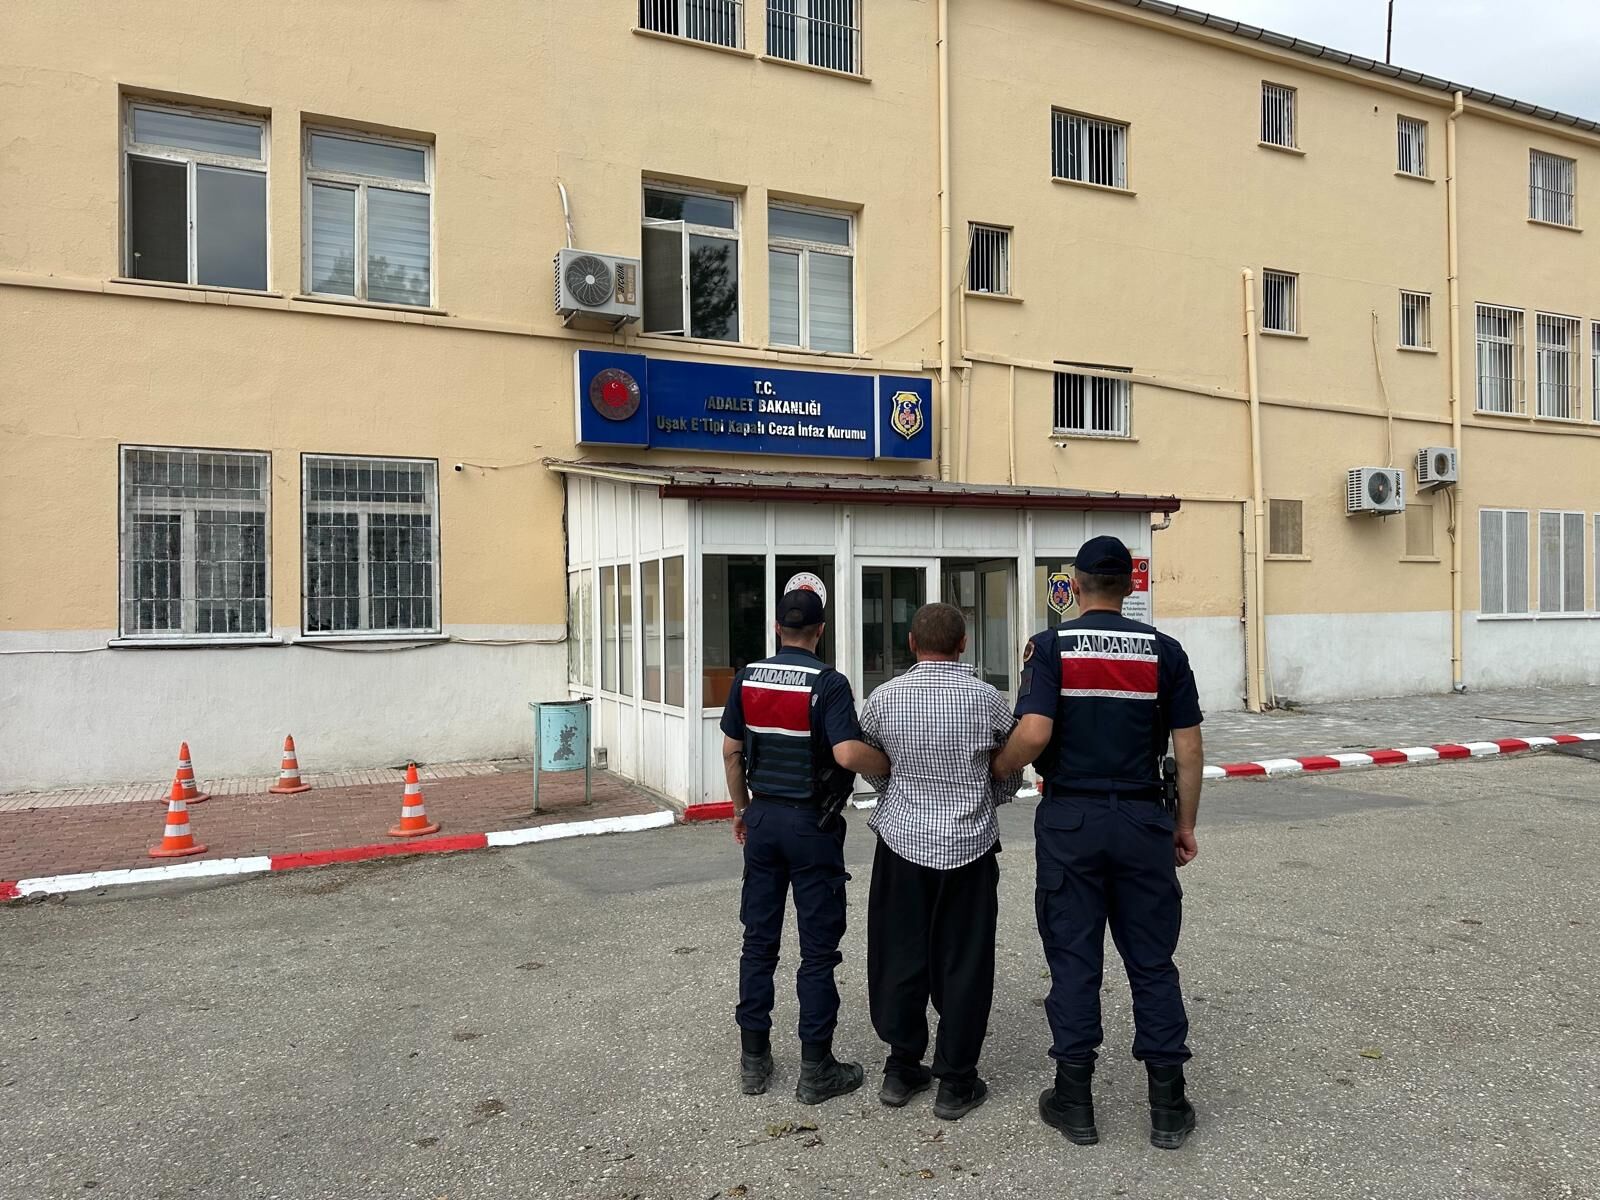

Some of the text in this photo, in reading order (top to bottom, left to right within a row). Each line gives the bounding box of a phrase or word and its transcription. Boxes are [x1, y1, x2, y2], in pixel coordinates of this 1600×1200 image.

[754, 381, 776, 395] T.C.
[707, 396, 821, 416] ADALET BAKANLIĞI
[656, 416, 867, 439] Uşak E Tipi Kapalı Ceza İnfaz Kurumu
[1073, 635, 1152, 654] JANDARMA
[750, 668, 806, 685] JANDARMA
